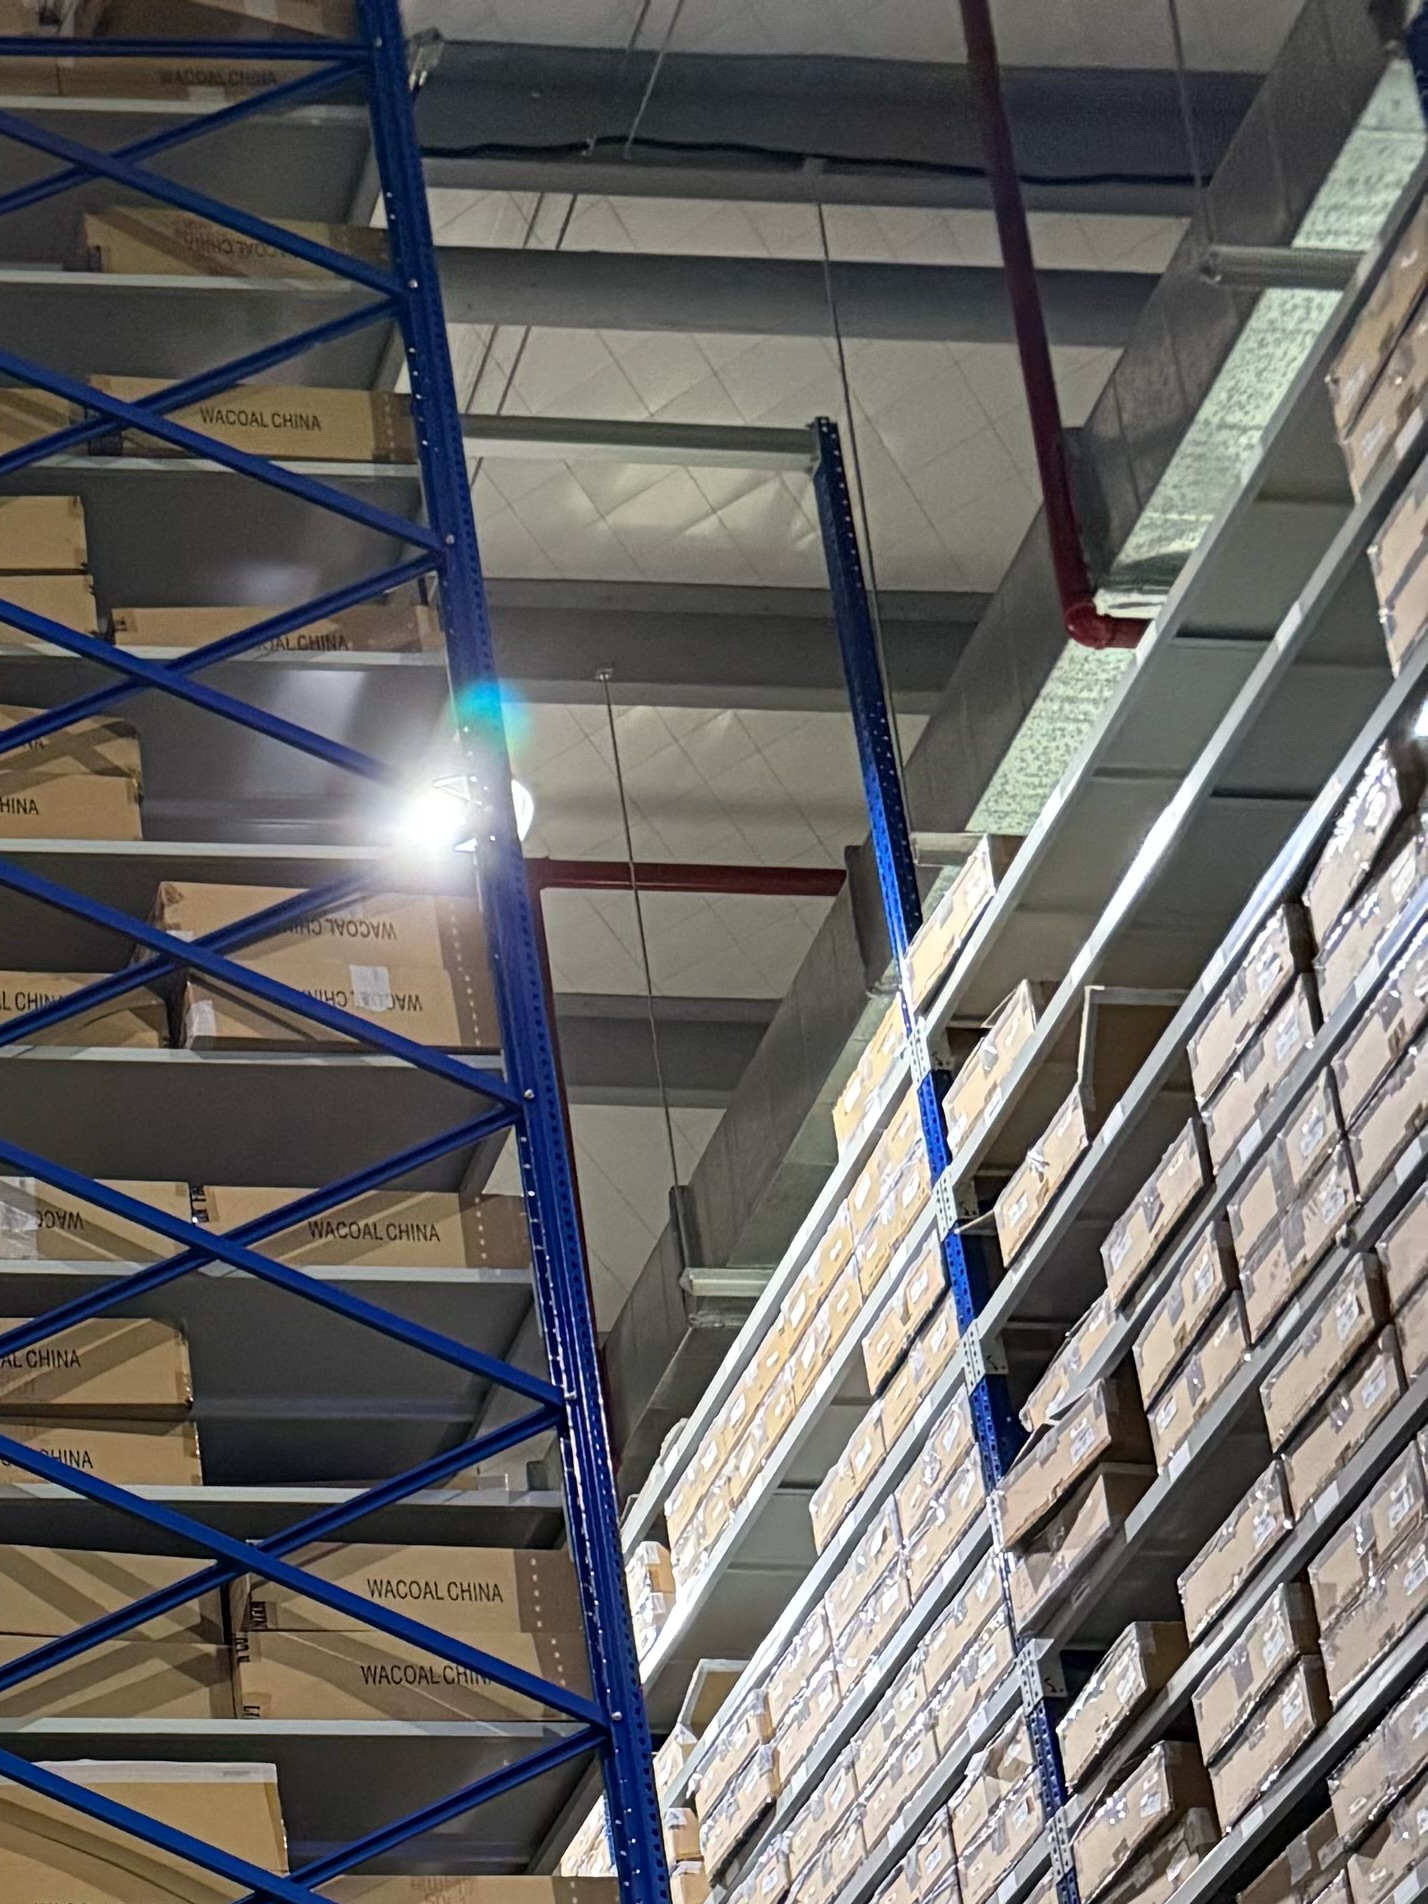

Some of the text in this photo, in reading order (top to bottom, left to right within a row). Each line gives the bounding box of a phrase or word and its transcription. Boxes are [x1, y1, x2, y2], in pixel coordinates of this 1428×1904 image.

[201, 407, 321, 432] WACOAL CHINA
[329, 917, 396, 939] WACOAL
[309, 1220, 441, 1243] WACOAL CHINA
[26, 1350, 80, 1370] CHINA
[368, 1579, 503, 1603] WACOAL CHINA
[361, 1665, 439, 1686] WACOAL
